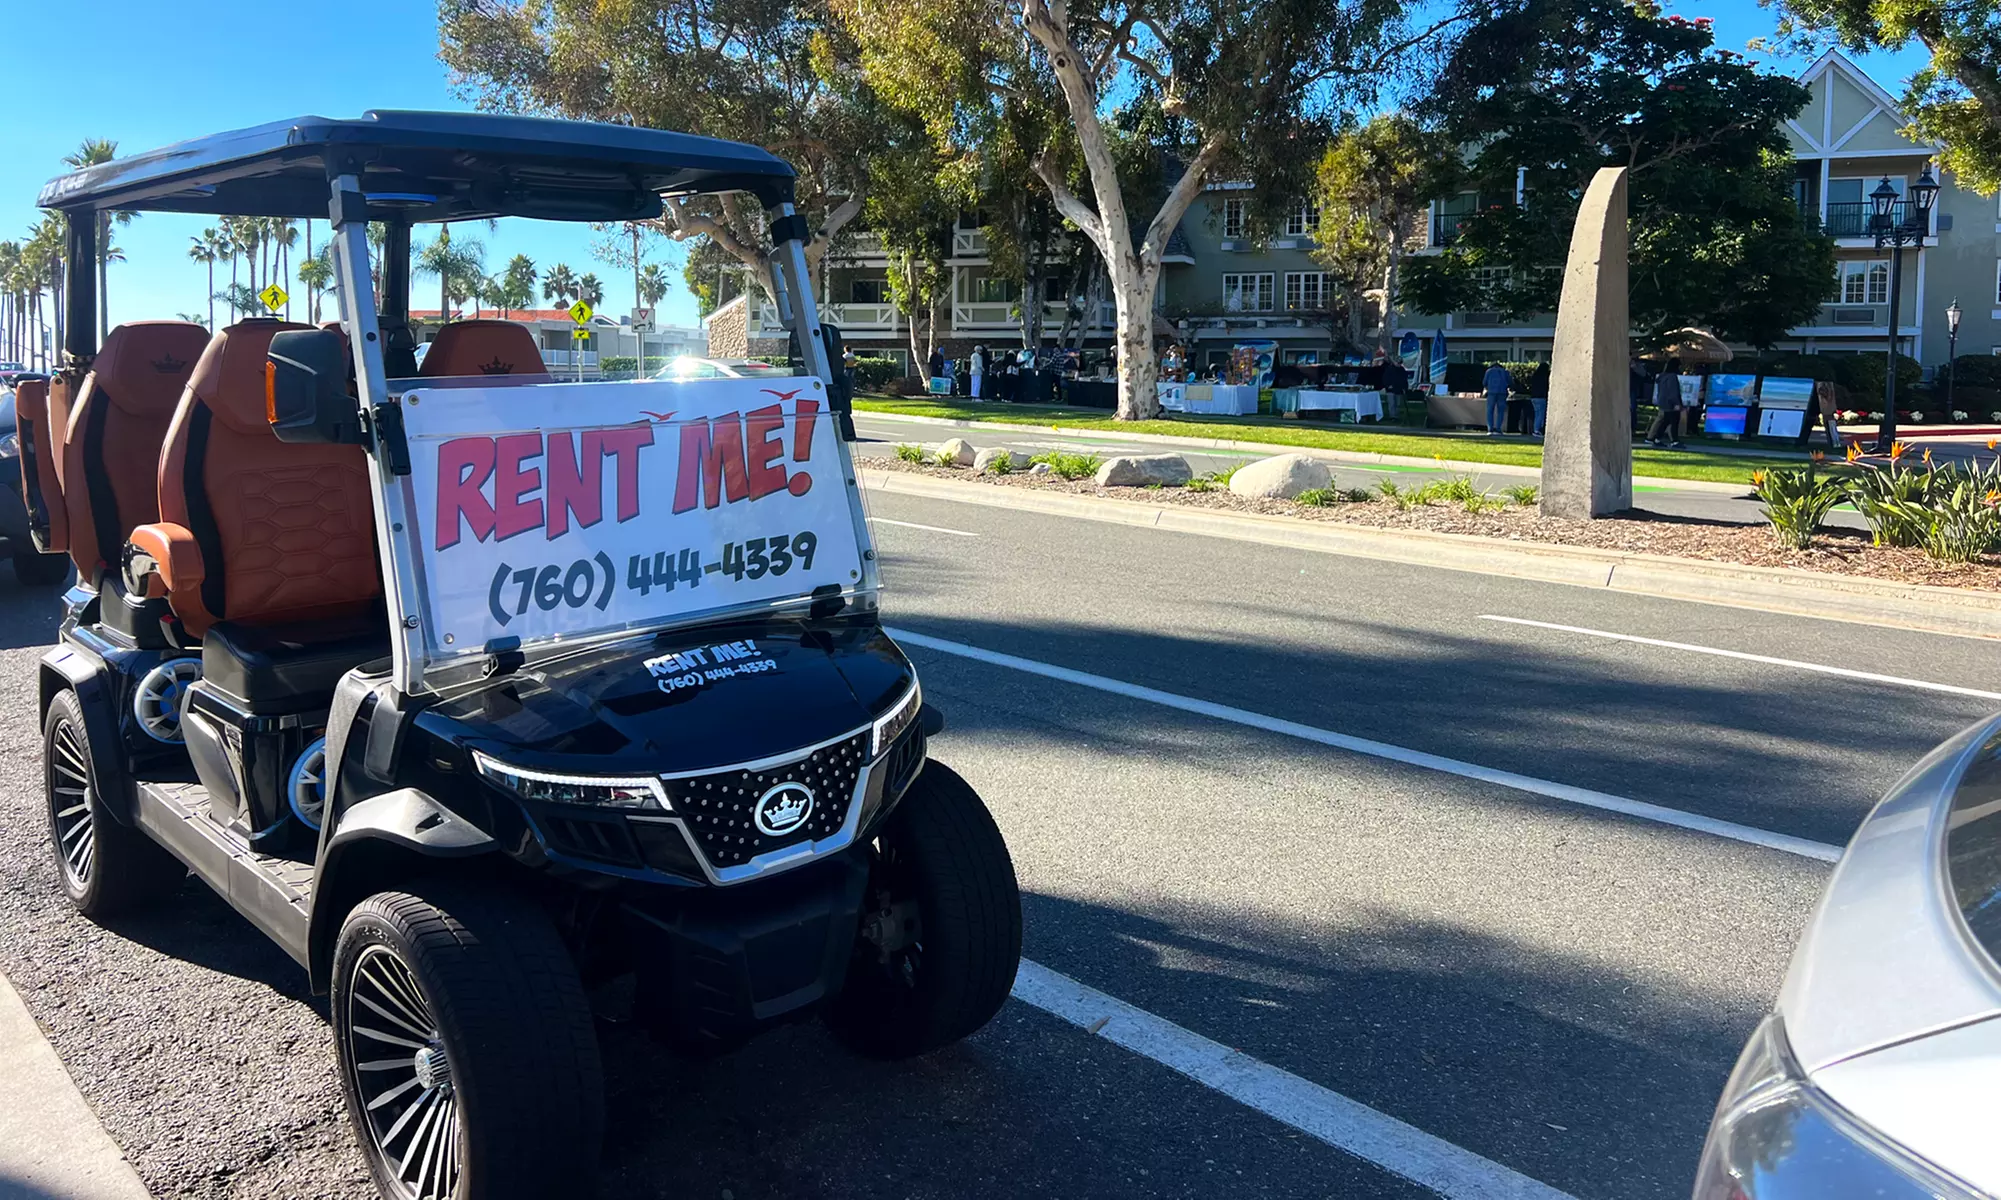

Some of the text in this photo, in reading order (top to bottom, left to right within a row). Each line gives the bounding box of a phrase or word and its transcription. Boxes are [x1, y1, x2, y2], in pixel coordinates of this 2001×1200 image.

[435, 399, 819, 552] RENT ME!
[489, 531, 817, 627] (760) 444-4339
[643, 639, 761, 677] RENT ME!
[657, 659, 777, 693] (760) 444-4339
